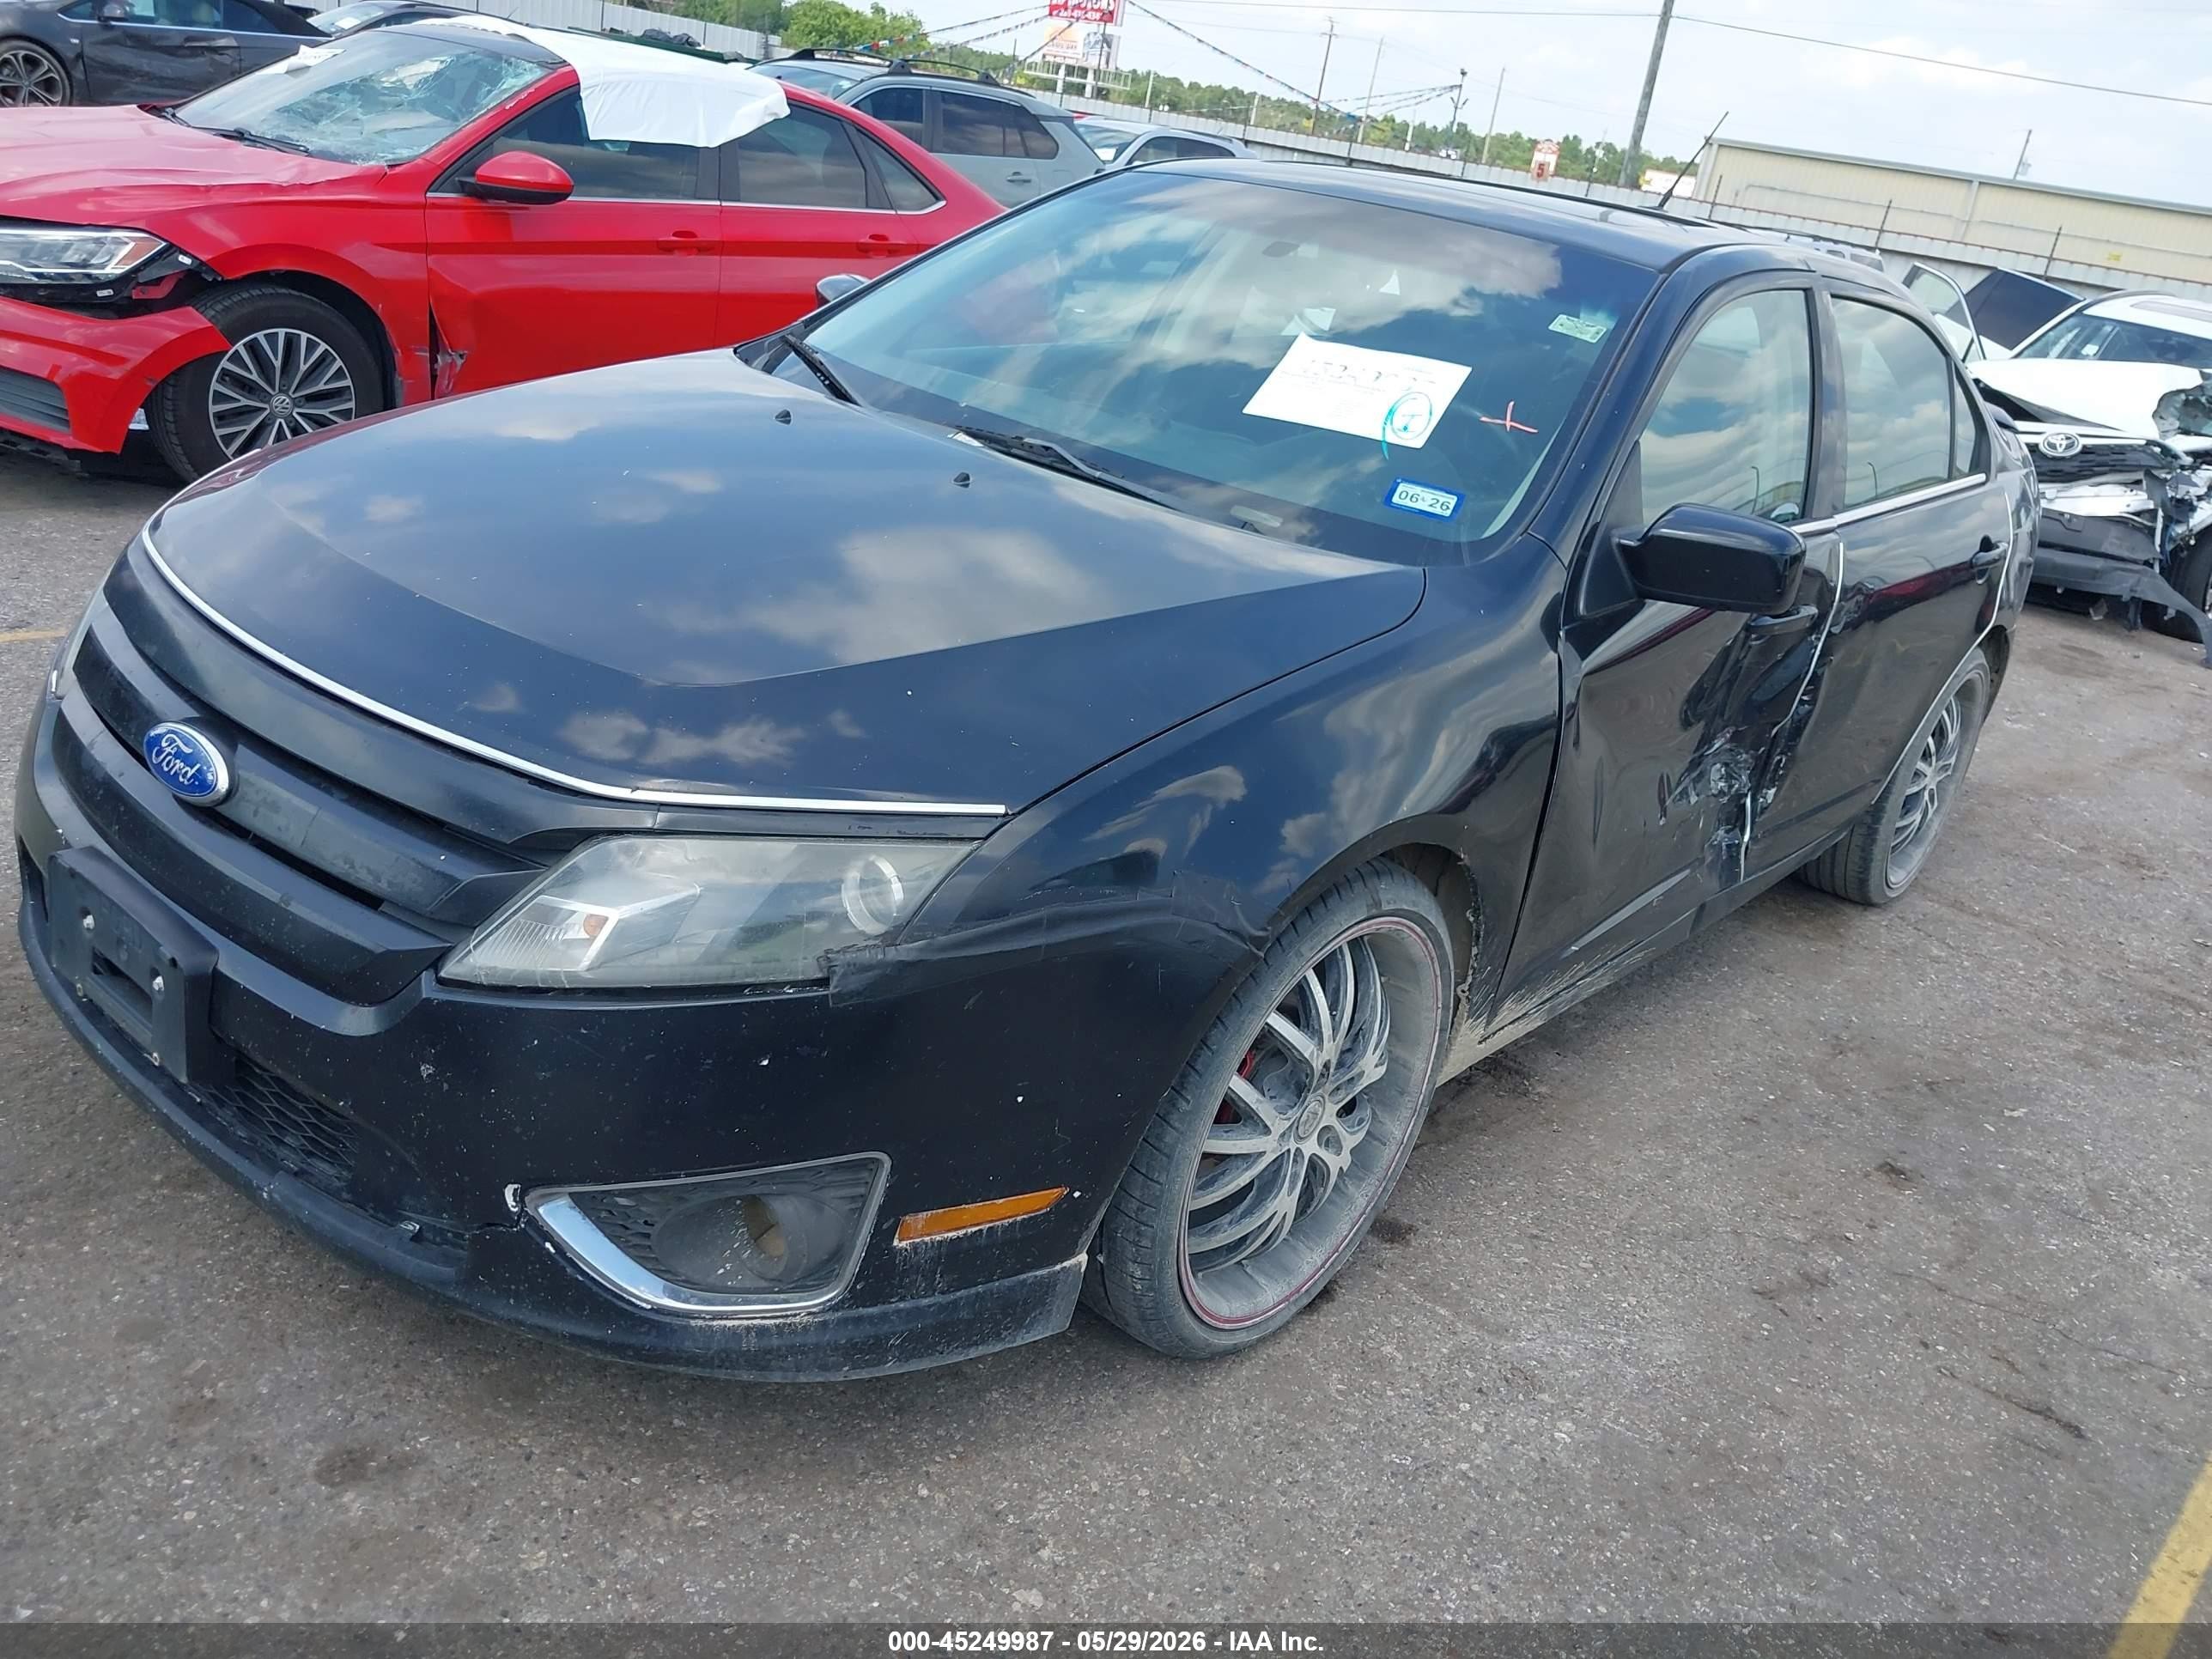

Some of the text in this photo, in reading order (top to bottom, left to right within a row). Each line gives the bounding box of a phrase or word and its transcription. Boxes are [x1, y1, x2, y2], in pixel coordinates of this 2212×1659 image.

[1398, 490, 1420, 503] 06
[1428, 498, 1451, 511] 26
[152, 733, 201, 785] Ford
